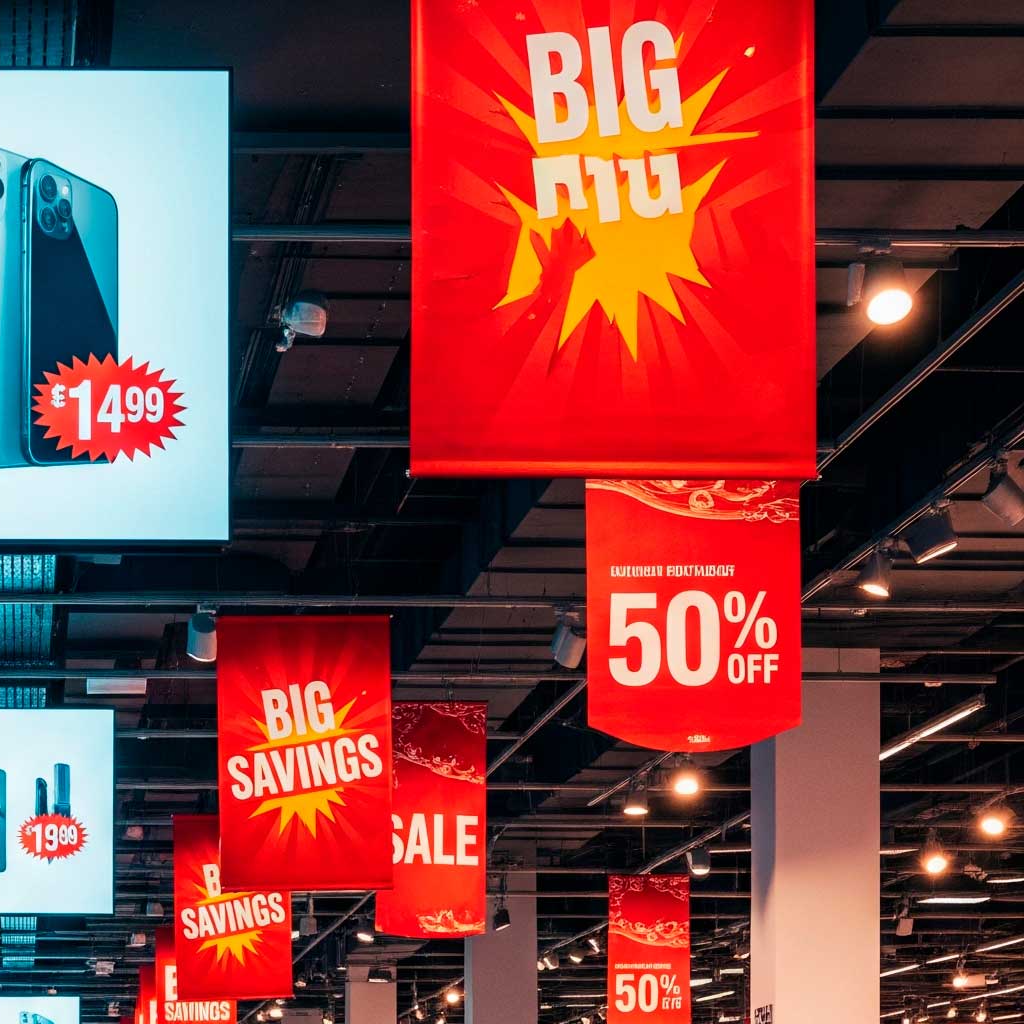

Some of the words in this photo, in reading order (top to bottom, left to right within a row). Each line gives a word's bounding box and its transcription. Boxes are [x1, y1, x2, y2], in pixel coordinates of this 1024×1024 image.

[526, 21, 683, 143] BIG
[609, 590, 779, 686] 50%
[728, 654, 779, 684] OFF
[261, 681, 335, 741] BIG
[228, 734, 382, 800] SAVINGS
[393, 813, 478, 866] SALE
[181, 889, 285, 939] SAVINGS
[615, 974, 682, 1012] 50%
